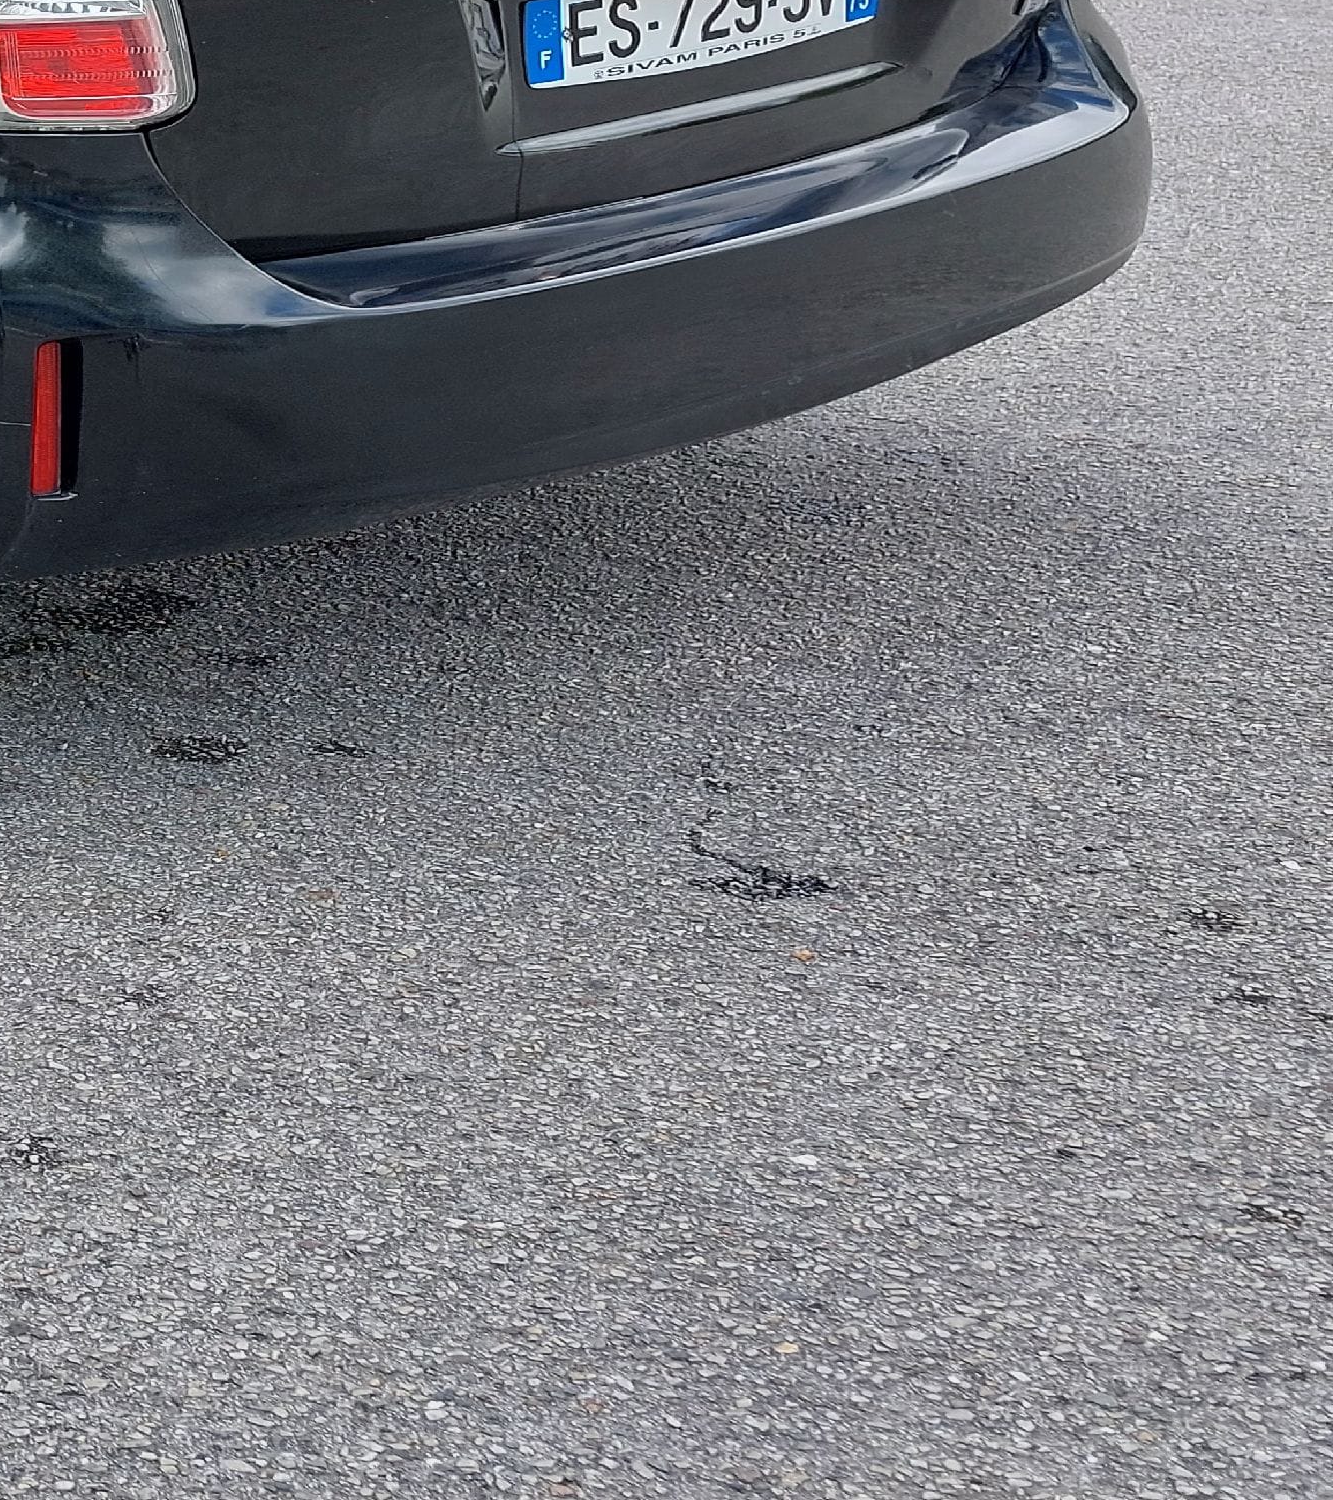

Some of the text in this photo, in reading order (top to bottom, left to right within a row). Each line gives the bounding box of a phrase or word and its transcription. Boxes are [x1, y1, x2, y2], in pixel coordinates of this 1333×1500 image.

[539, 49, 552, 72] F
[605, 51, 698, 78] SIVAM
[708, 34, 786, 58] PARIS
